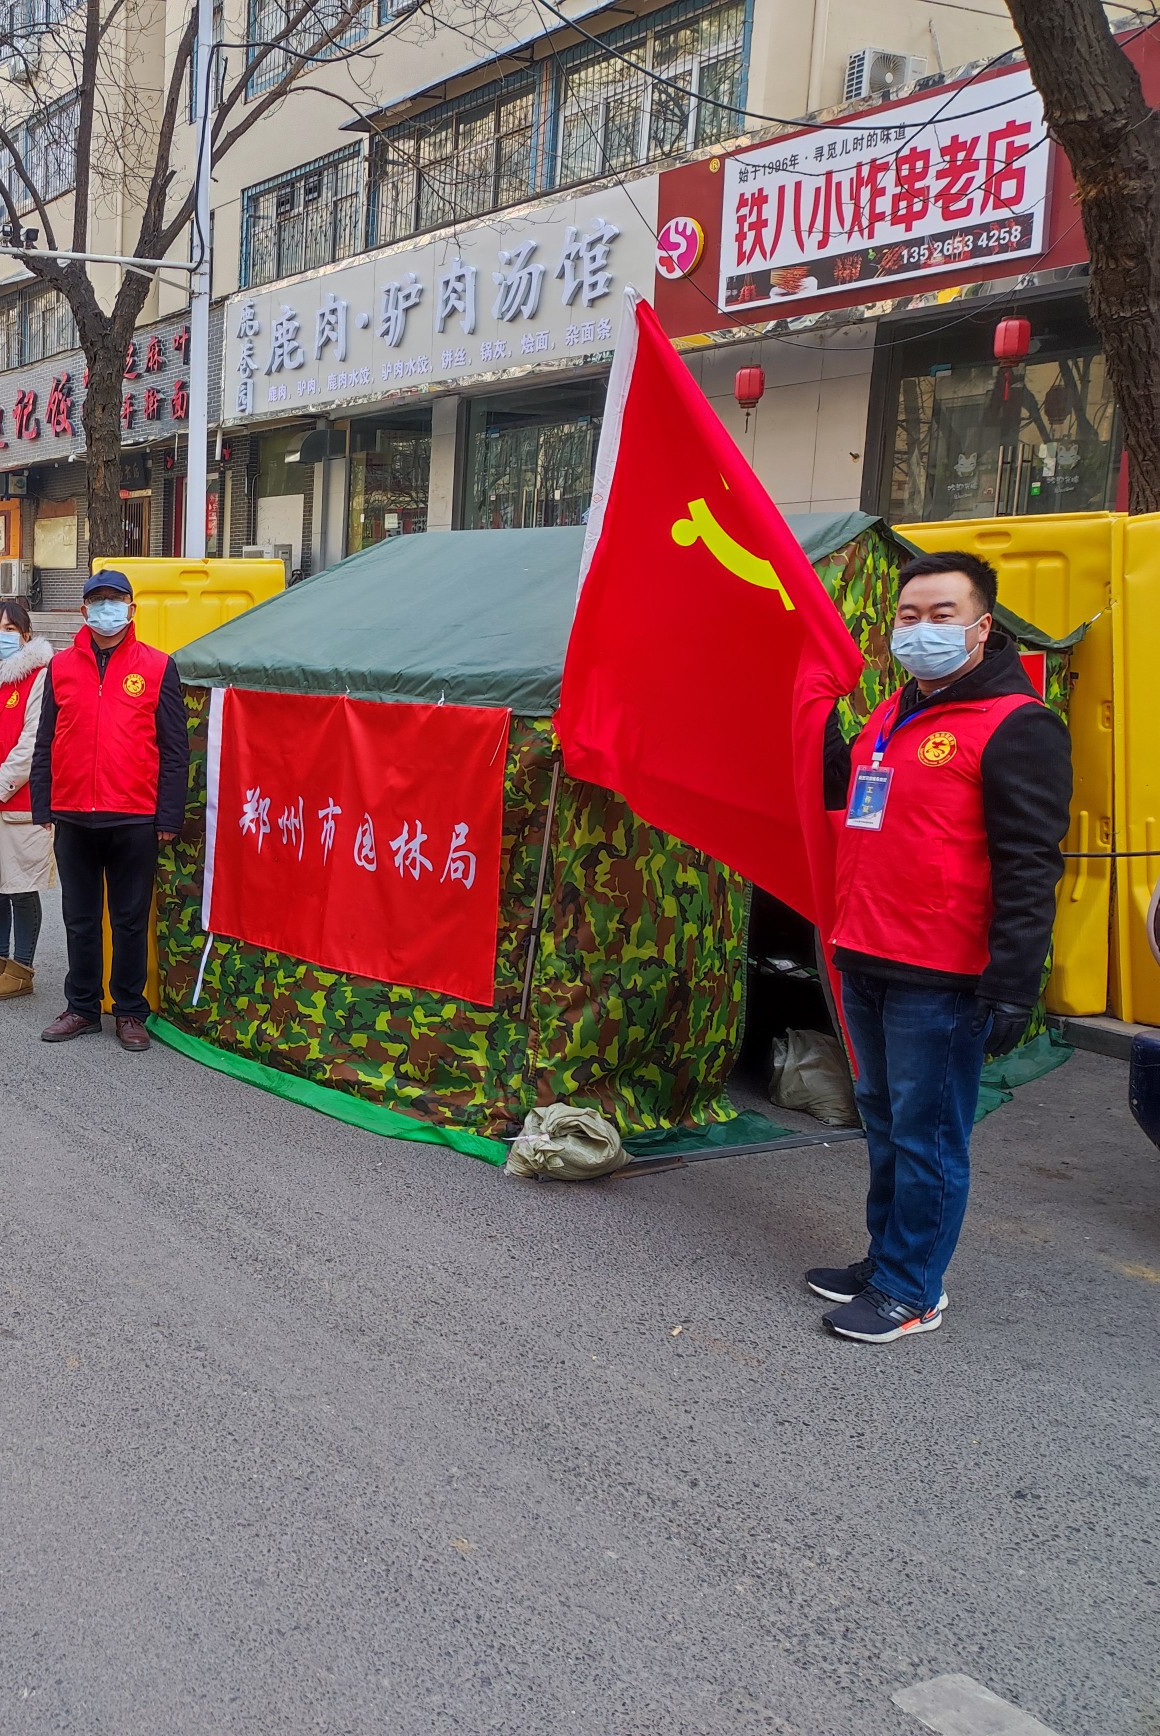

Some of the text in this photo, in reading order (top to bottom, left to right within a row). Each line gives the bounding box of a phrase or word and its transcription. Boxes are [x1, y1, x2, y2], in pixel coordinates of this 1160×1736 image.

[735, 119, 1032, 268] 铁八小炸串老店
[901, 225, 1022, 264] 135 2653 4258
[239, 786, 477, 890] 郑州市园林局
